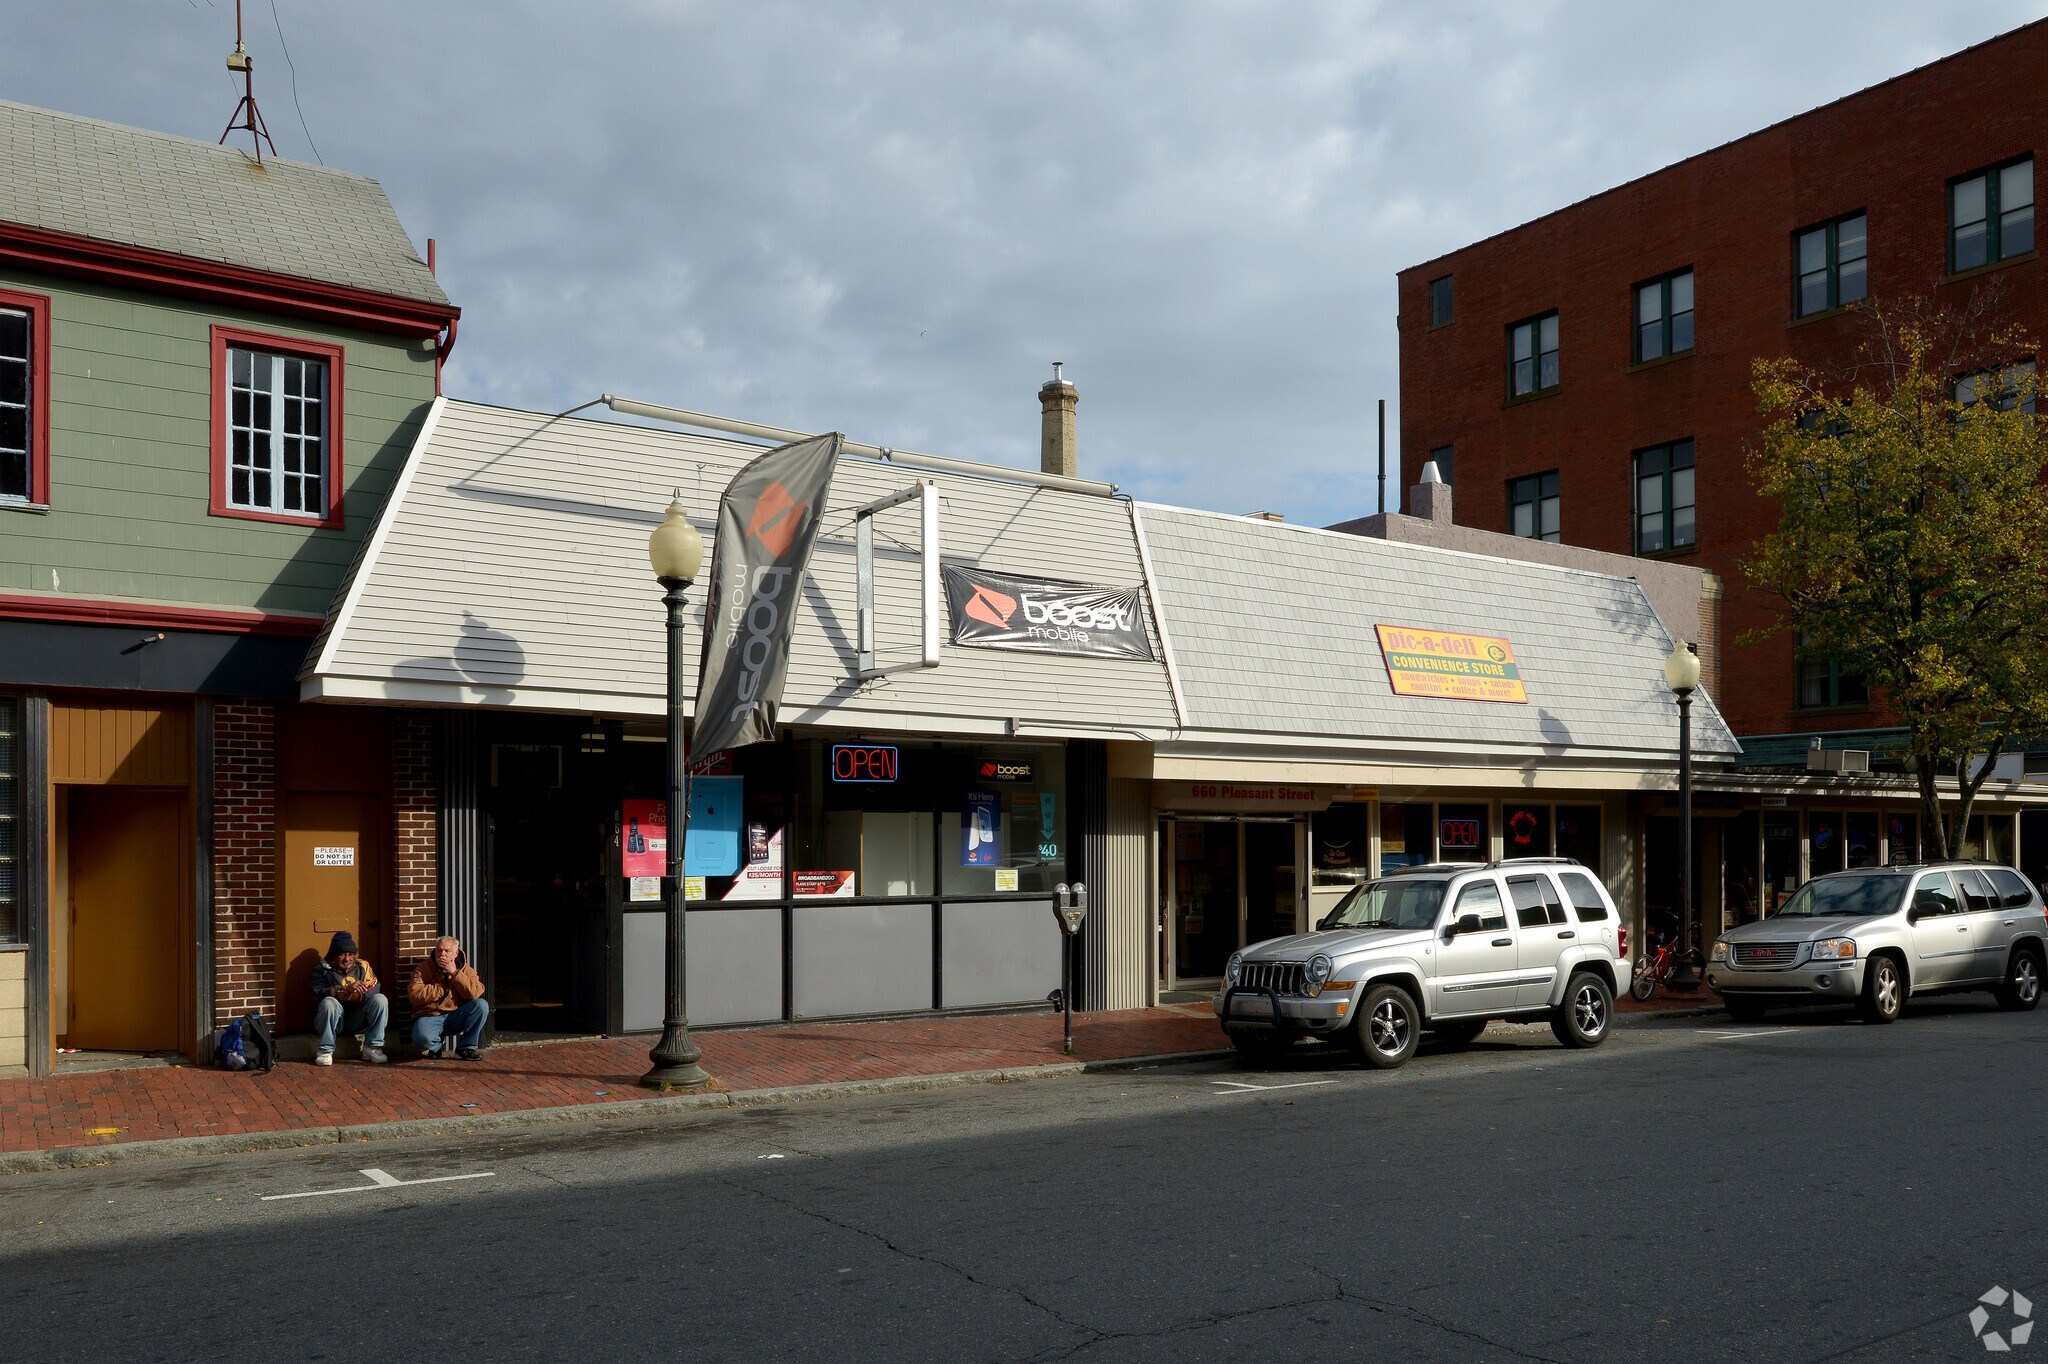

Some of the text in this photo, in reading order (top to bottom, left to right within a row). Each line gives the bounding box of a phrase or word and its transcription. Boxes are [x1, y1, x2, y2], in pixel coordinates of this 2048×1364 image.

[725, 563, 748, 649] mobile
[1020, 593, 1131, 631] boost
[731, 565, 793, 722] boost
[1028, 626, 1089, 642] mobile
[1387, 631, 1478, 656] pic-a-deli
[1393, 655, 1505, 676] CONVENIENCE STORE
[835, 749, 895, 778] OPEN
[997, 764, 1030, 775] boost
[978, 793, 994, 801] Here
[1192, 785, 1315, 800] 660 Pleasant Street
[1443, 822, 1478, 845] OPEN
[1038, 844, 1057, 857] $40
[1750, 949, 1777, 957] GMC
